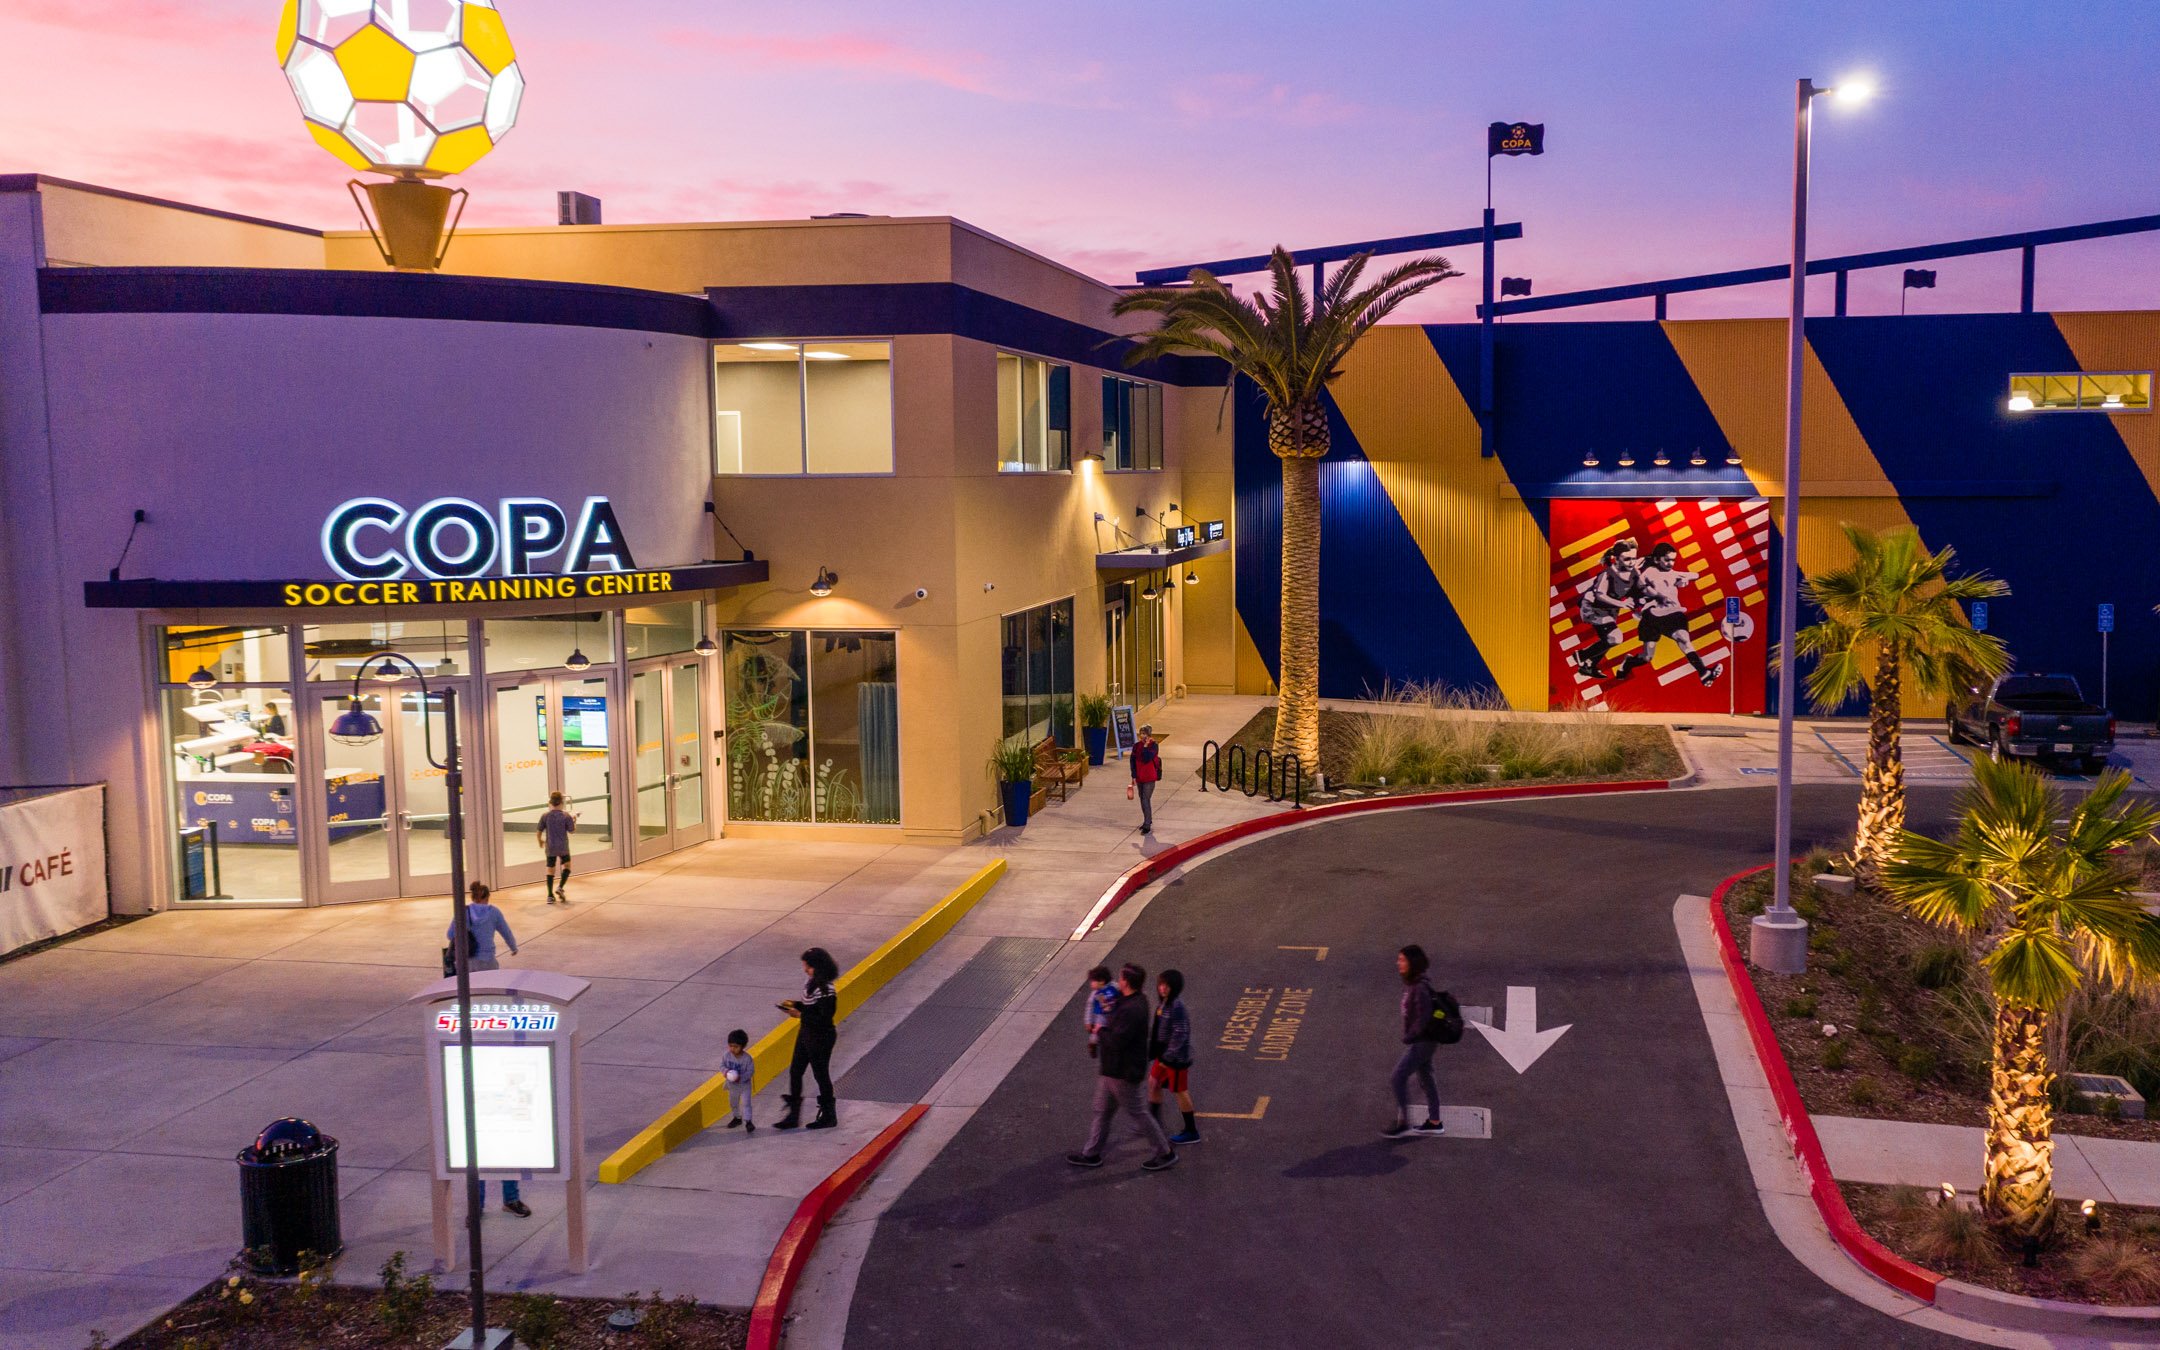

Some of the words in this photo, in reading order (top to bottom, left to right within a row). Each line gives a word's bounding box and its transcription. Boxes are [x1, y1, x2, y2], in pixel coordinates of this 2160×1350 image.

[1502, 139, 1532, 148] COPA
[321, 496, 638, 580] COPA
[285, 582, 419, 606] SOCCER
[430, 577, 576, 602] TRAINING
[586, 572, 672, 596] CENTER
[516, 759, 543, 769] COPA
[207, 794, 234, 802] COPA
[20, 846, 73, 887] CAFÉ
[1275, 987, 1313, 1015] ZONE
[1216, 987, 1274, 1051] ACCESSIBLE
[1254, 1017, 1302, 1061] LOADING
